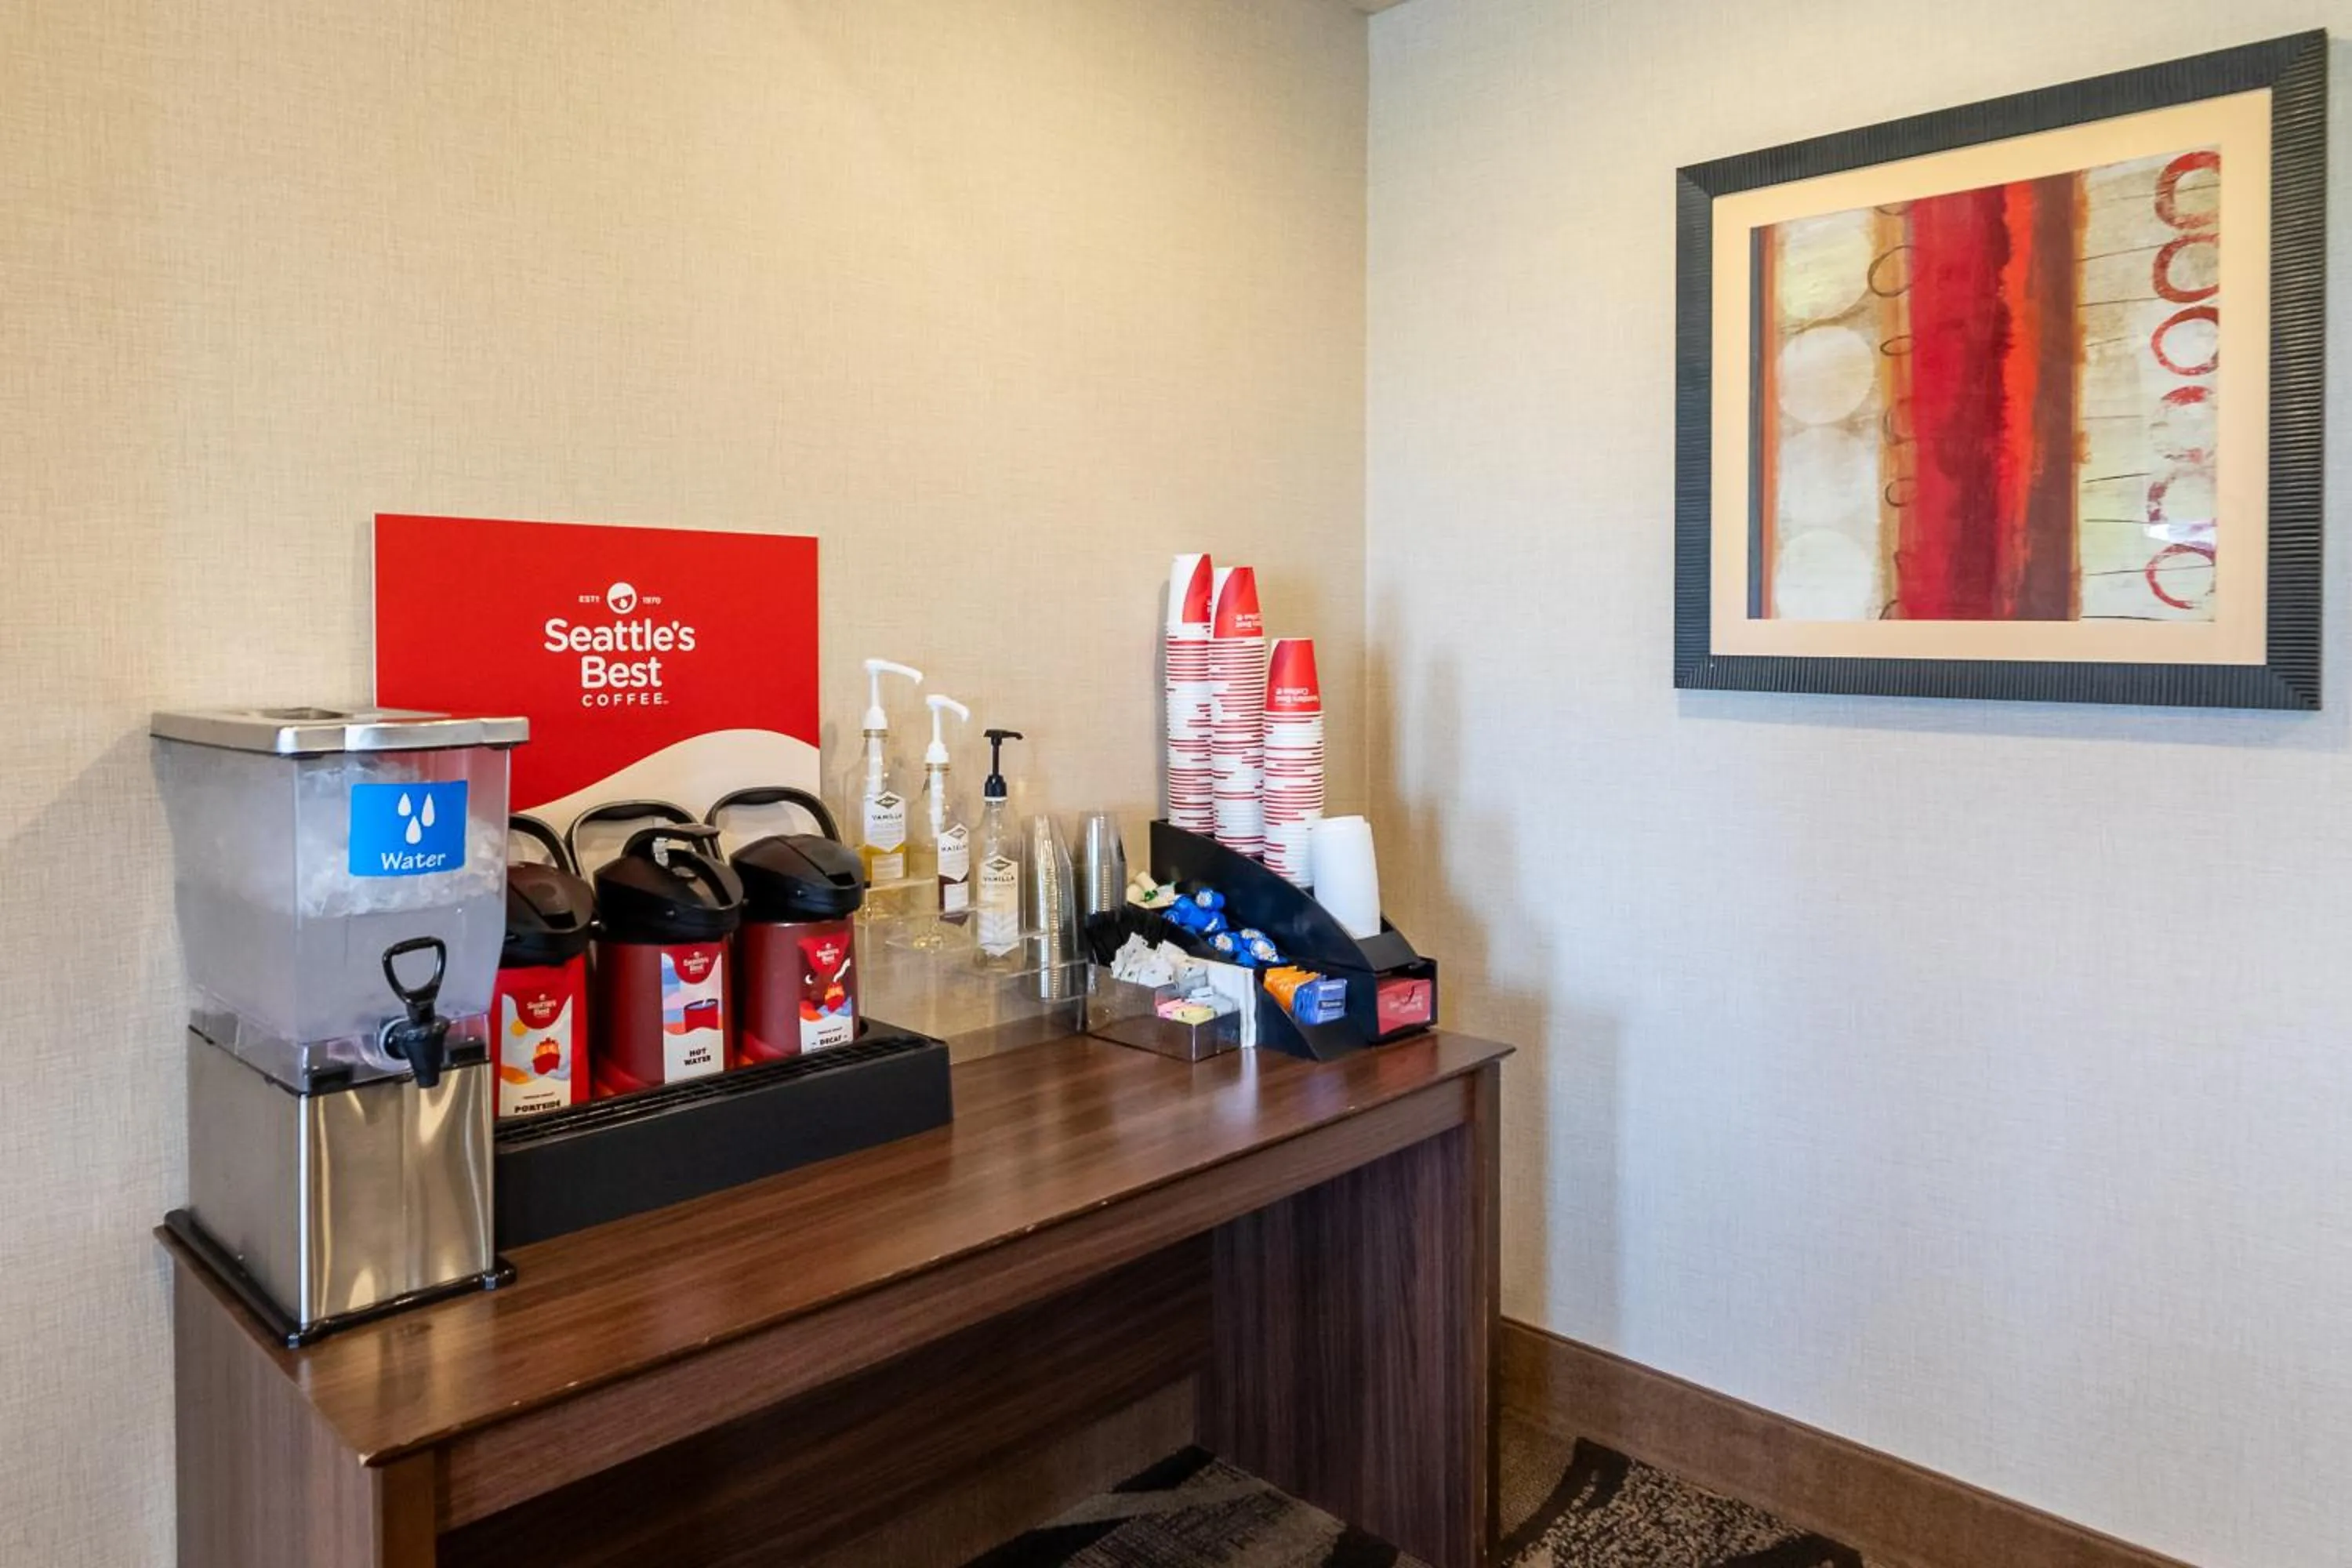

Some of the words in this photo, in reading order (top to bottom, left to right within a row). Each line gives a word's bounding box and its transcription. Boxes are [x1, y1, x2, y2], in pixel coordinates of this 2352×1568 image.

[544, 617, 696, 652] Seattle's
[581, 655, 662, 689] Best
[381, 851, 446, 871] Water
[819, 1034, 841, 1045] DECAF
[689, 1047, 707, 1057] HOT
[684, 1055, 711, 1066] WATER
